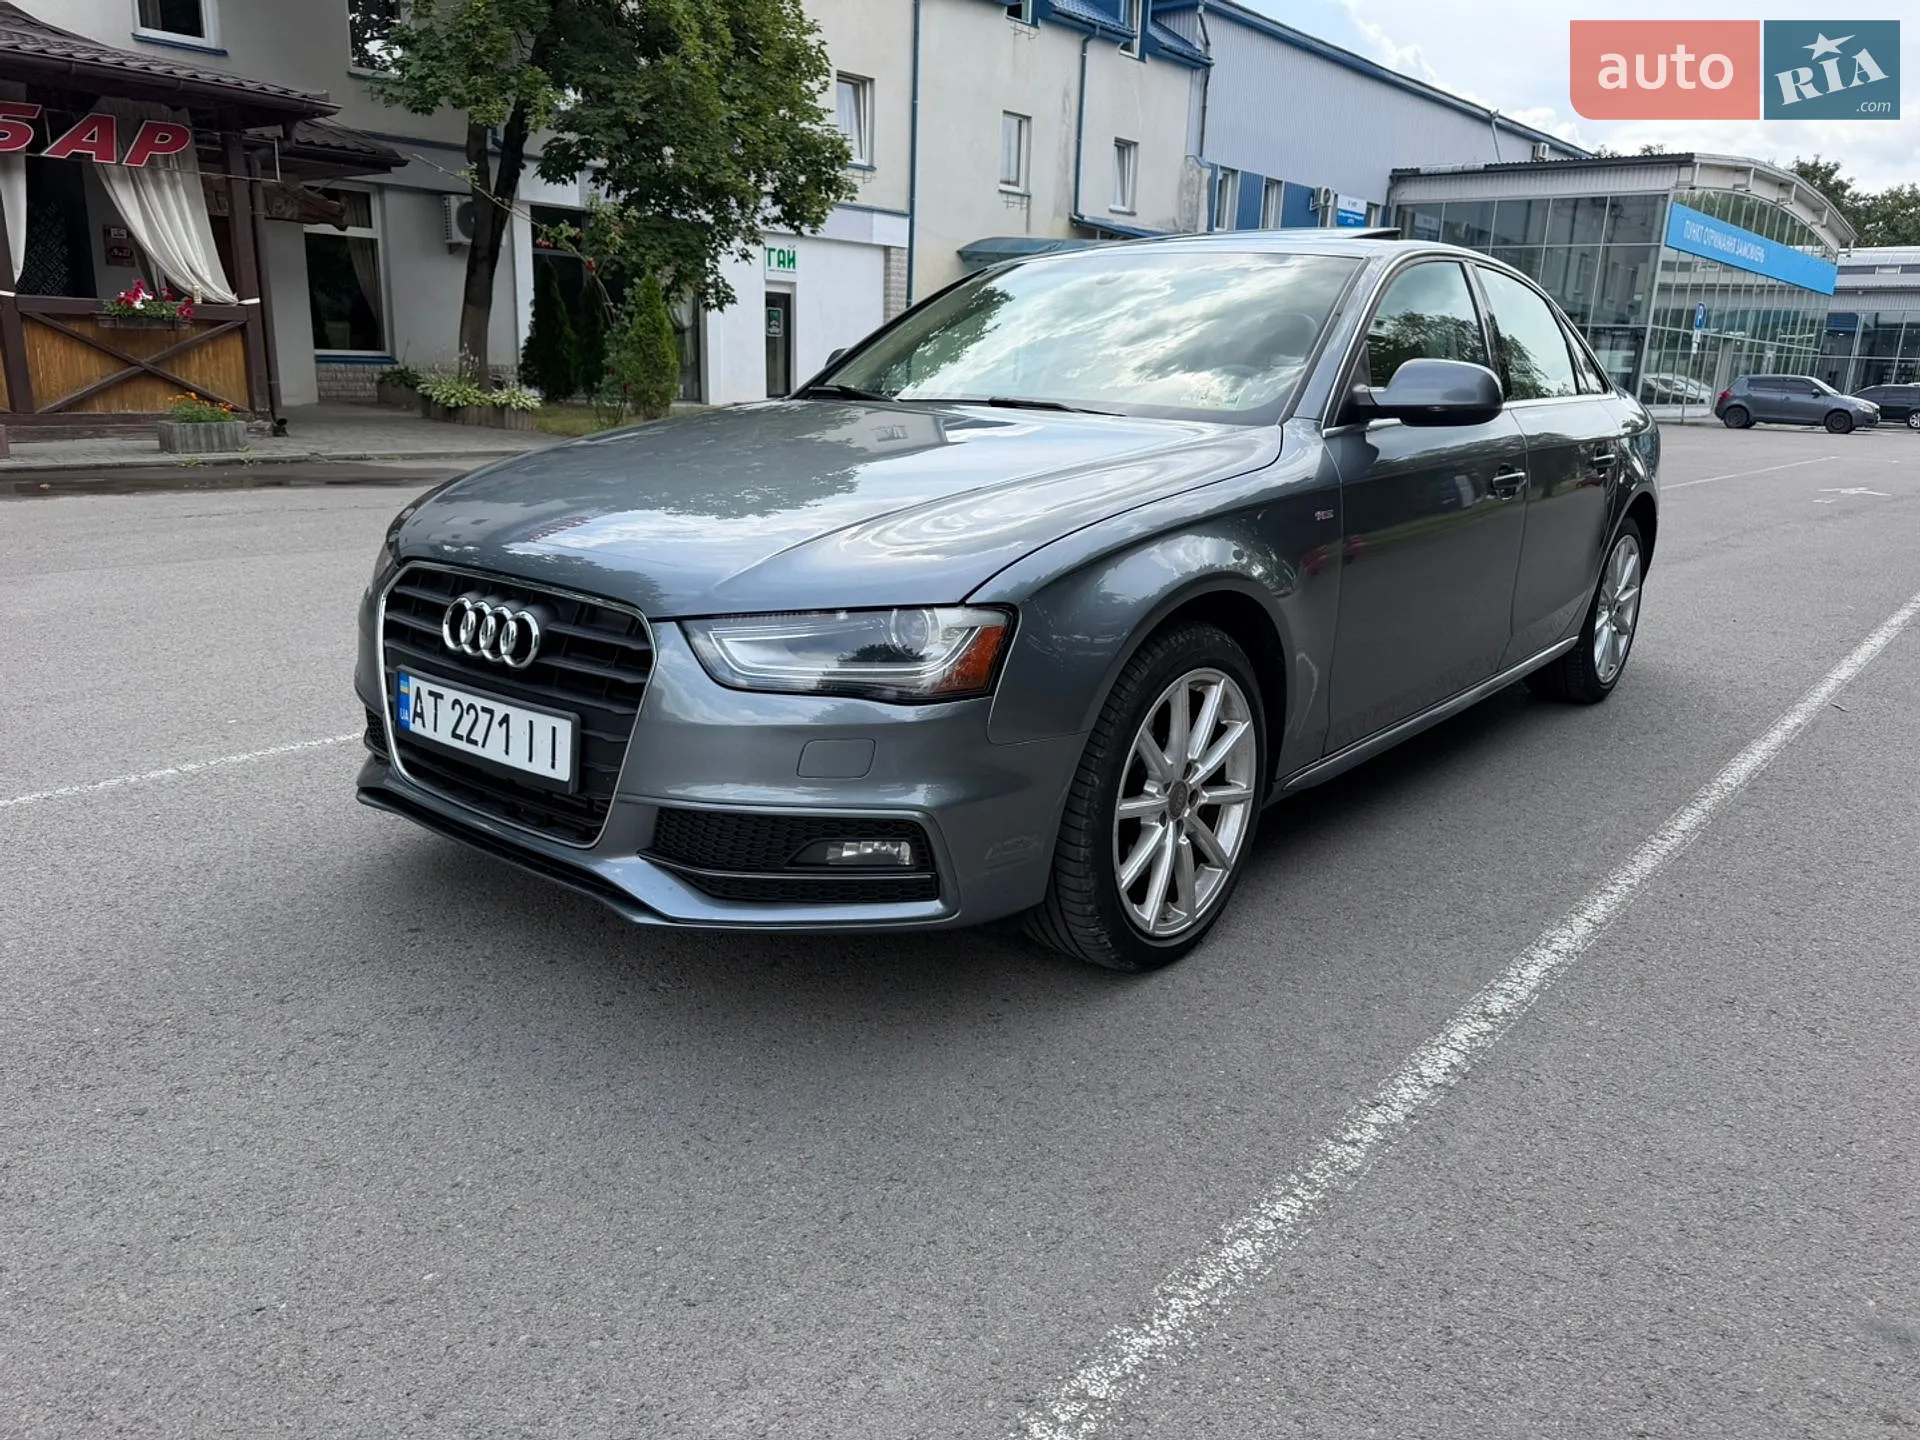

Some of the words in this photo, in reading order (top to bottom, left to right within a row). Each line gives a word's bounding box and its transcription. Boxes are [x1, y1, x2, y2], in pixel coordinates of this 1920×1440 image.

[400, 708, 409, 721] UA
[412, 686, 444, 732] AT
[451, 698, 511, 756] 2271
